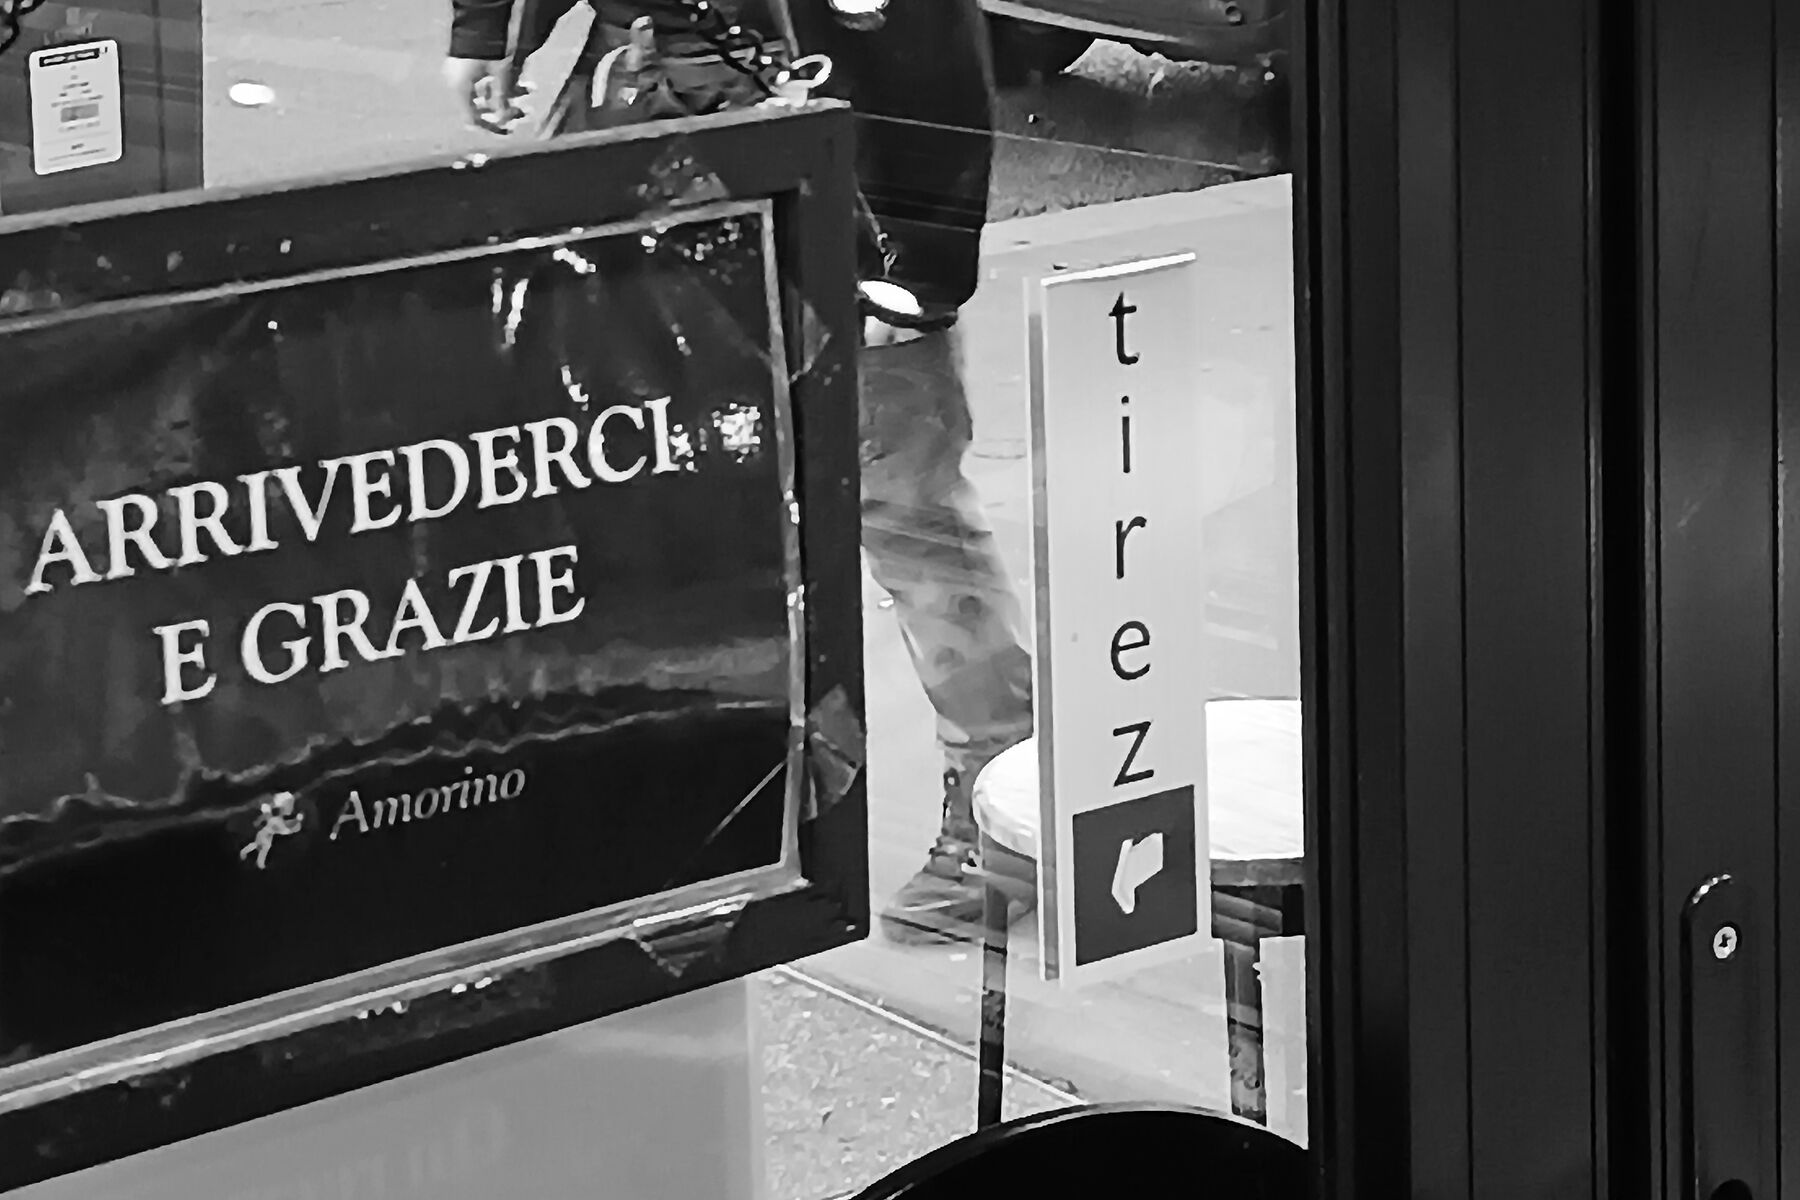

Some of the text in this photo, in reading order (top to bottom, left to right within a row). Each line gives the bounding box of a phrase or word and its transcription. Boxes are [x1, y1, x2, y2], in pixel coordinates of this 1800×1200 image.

[1108, 291, 1154, 787] tirez
[153, 545, 586, 704] E GRAZIE
[329, 766, 526, 841] Amorino
